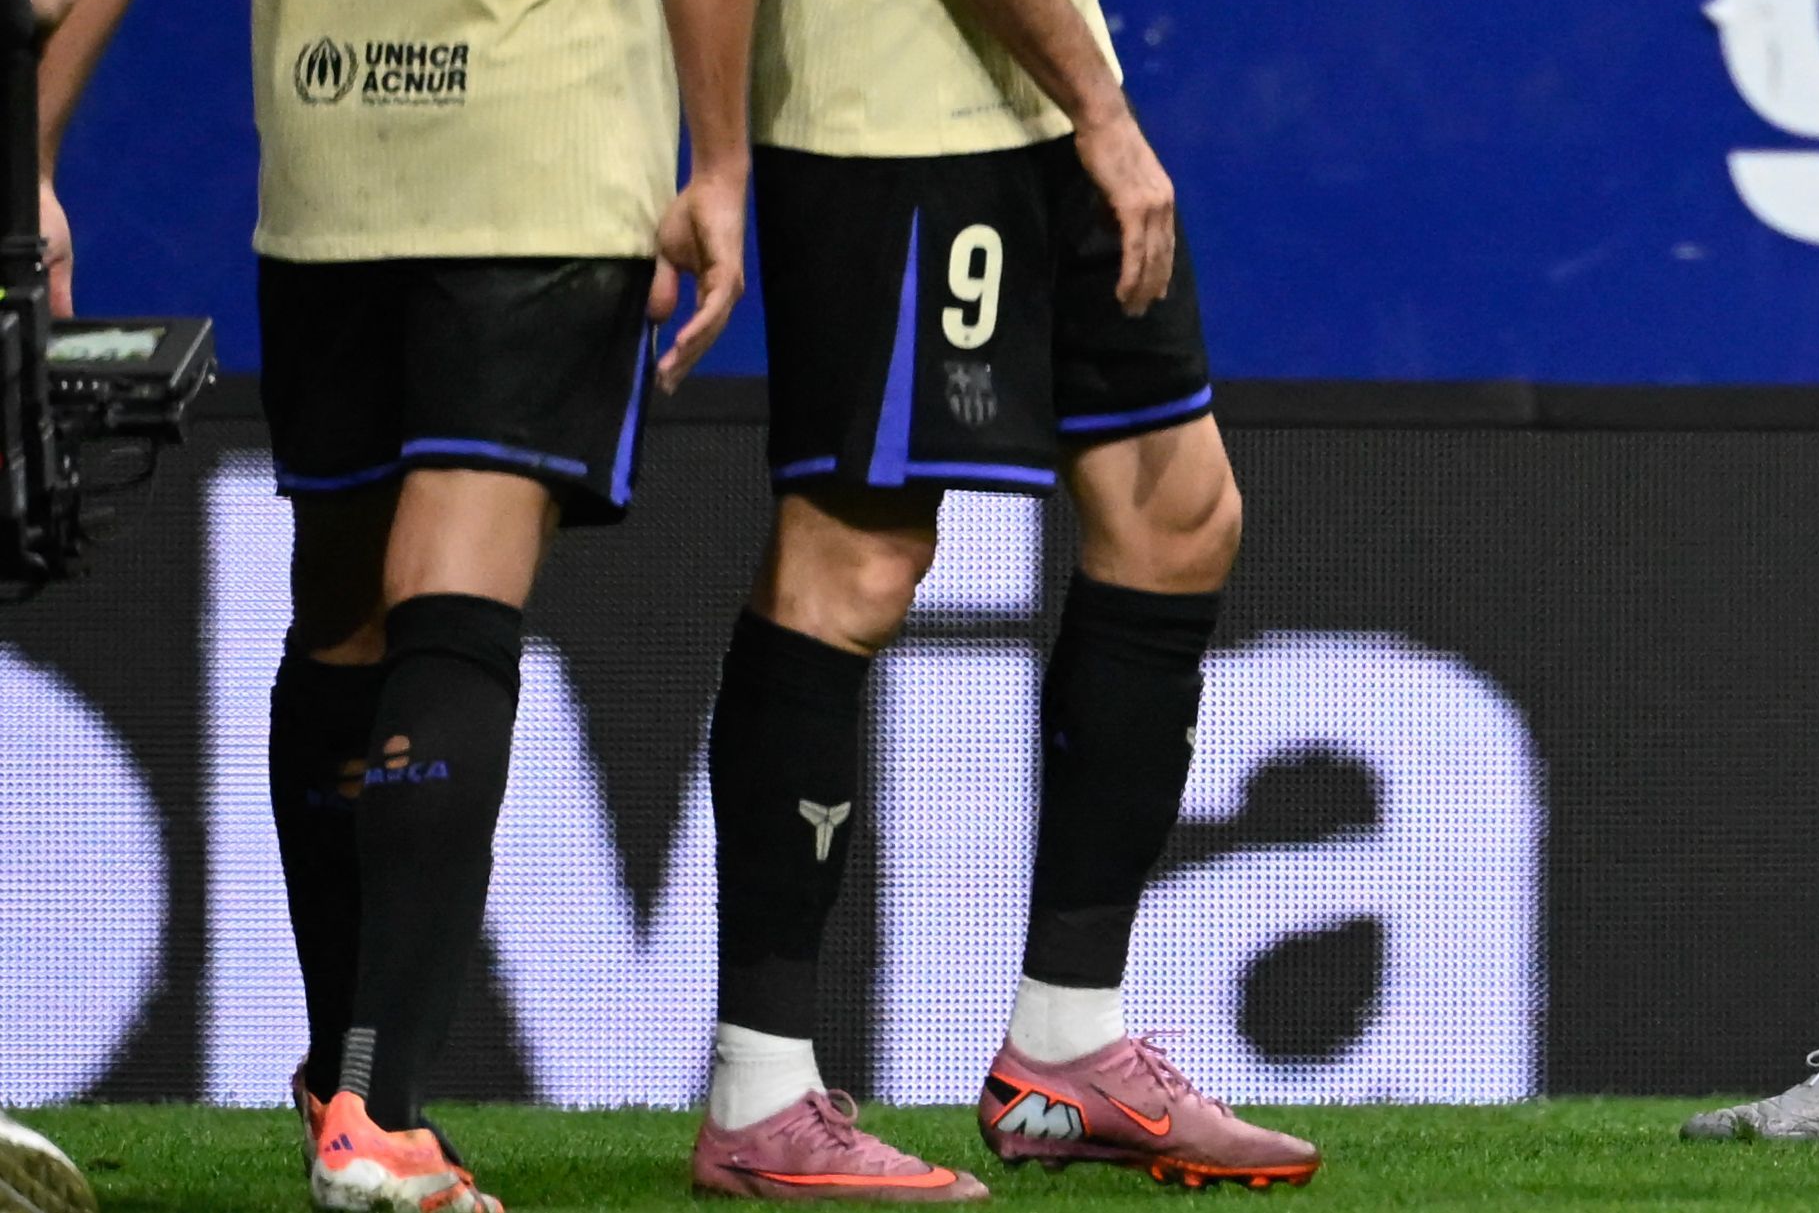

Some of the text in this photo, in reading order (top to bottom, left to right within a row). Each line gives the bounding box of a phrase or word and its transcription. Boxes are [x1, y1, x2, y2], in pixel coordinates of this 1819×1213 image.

[364, 41, 469, 68] UNHCR
[361, 70, 467, 93] ACNUR
[941, 223, 1004, 350] 9
